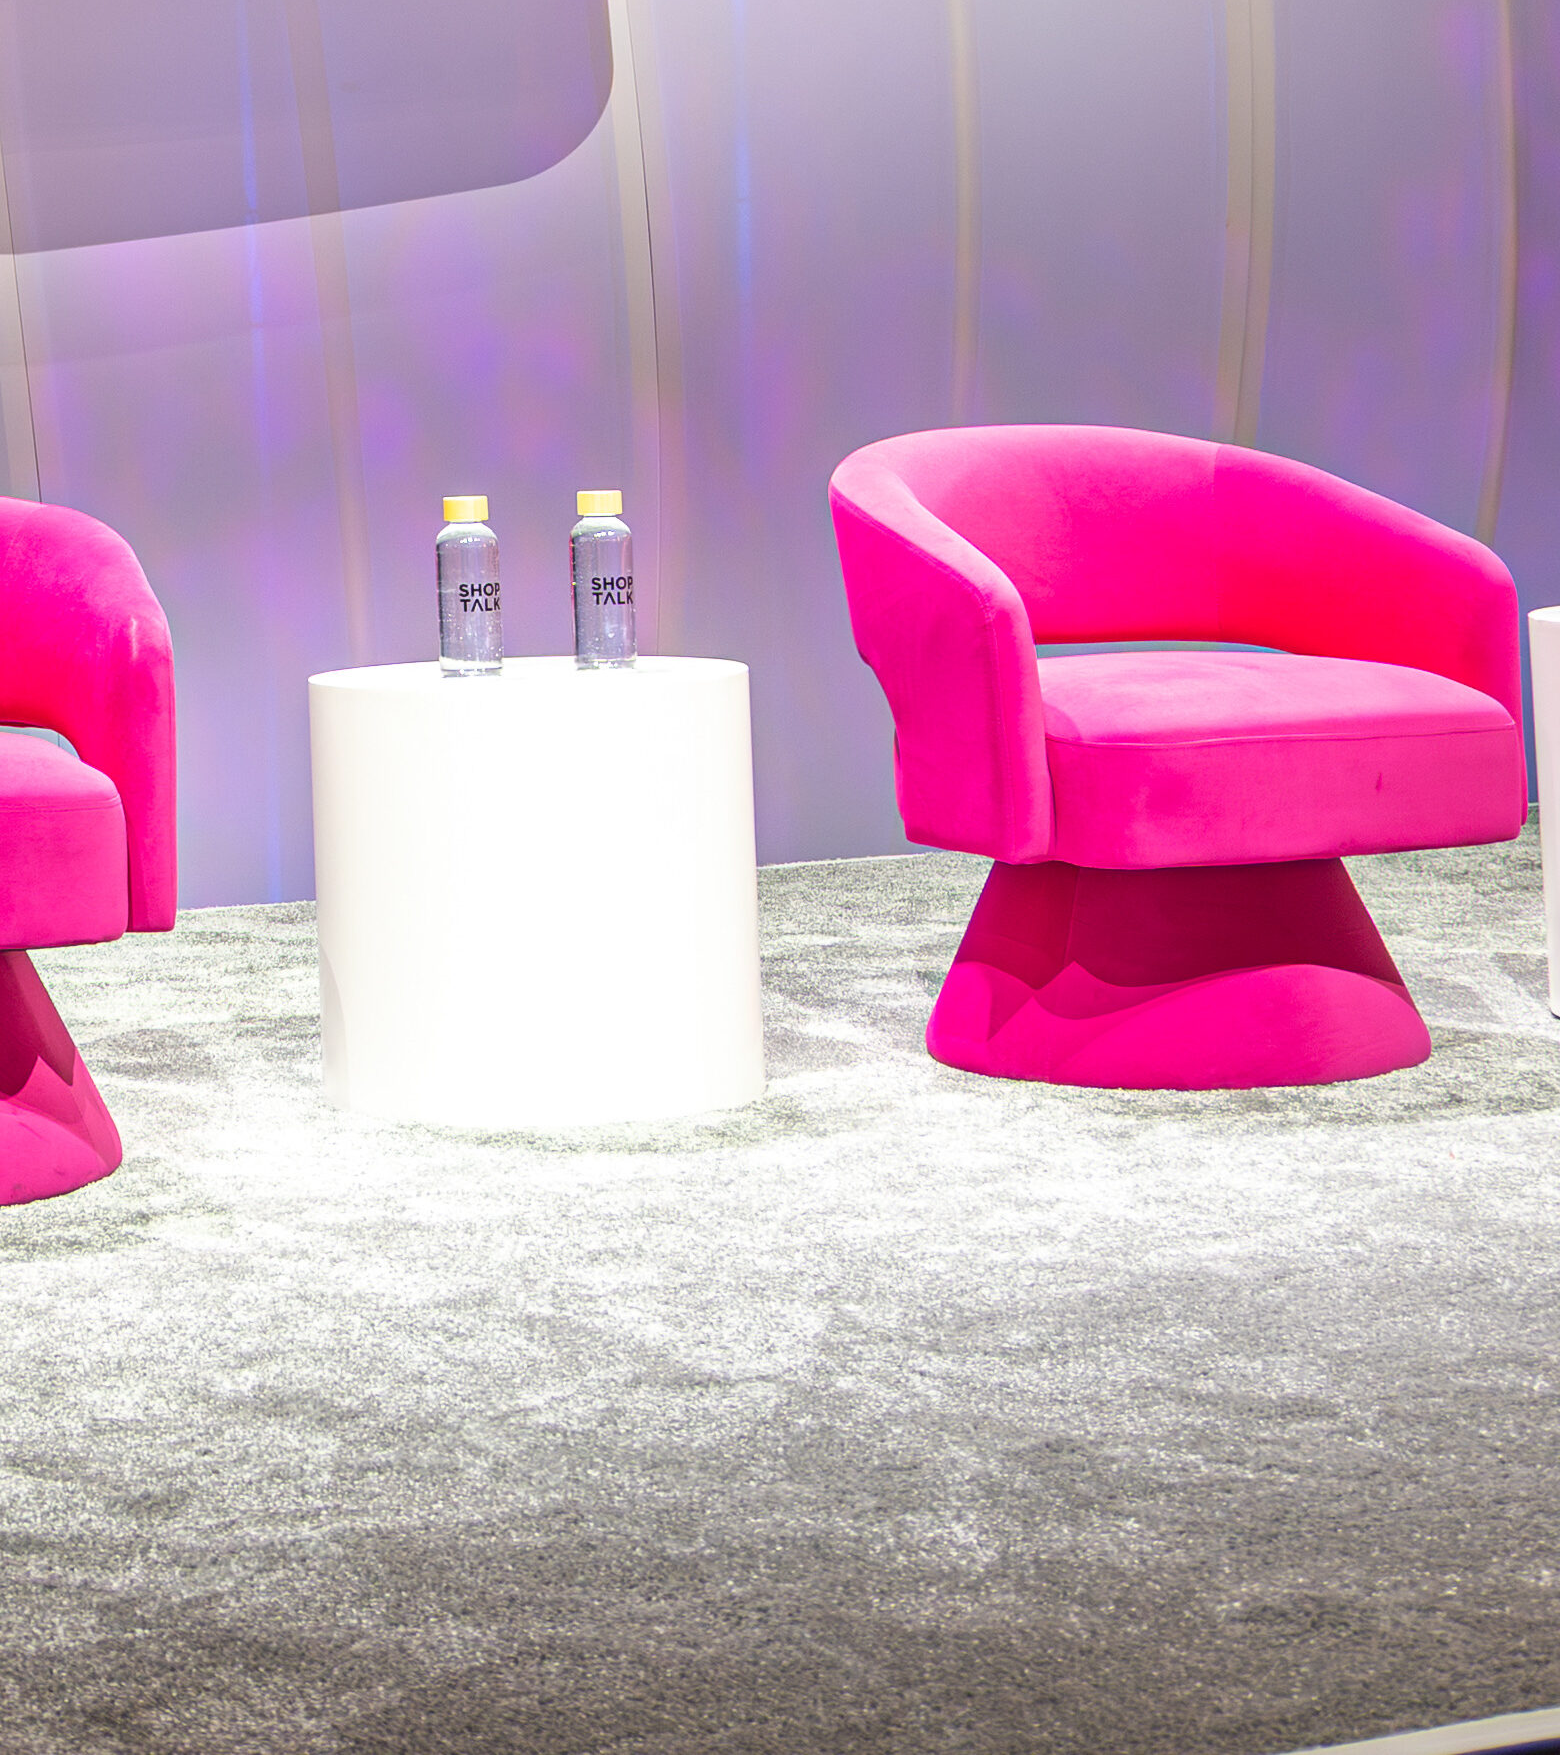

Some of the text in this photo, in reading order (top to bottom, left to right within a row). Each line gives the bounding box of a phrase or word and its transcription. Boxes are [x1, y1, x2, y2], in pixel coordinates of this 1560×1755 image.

[459, 582, 500, 598] SHOP
[591, 575, 633, 591] SHOP
[460, 597, 501, 613] TALK
[592, 590, 634, 605] TALK
